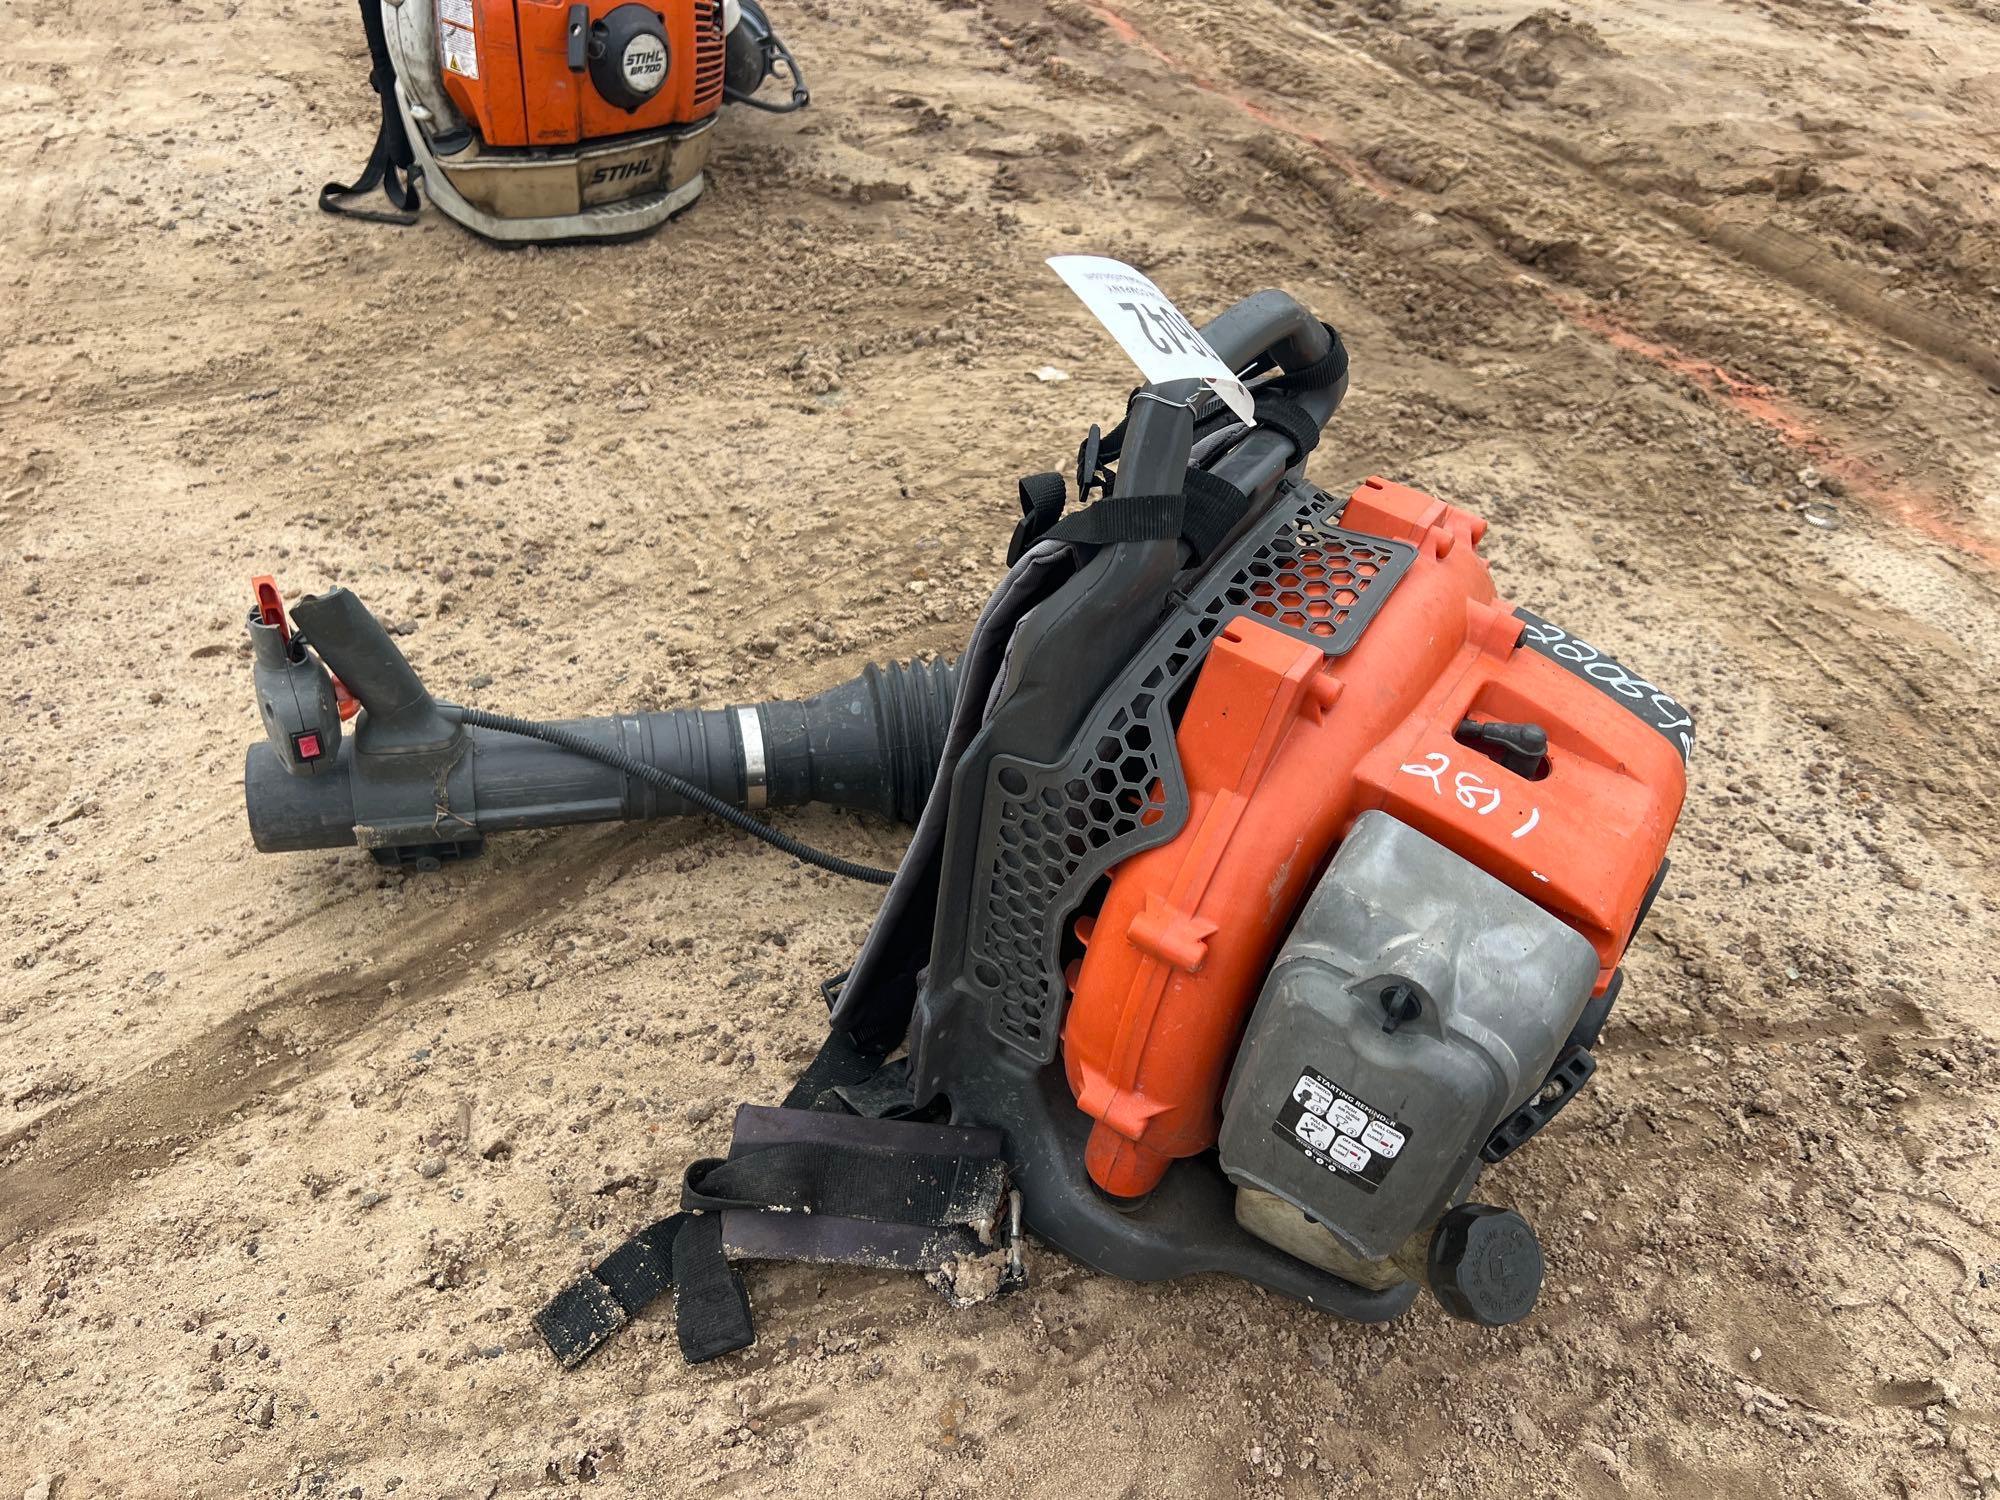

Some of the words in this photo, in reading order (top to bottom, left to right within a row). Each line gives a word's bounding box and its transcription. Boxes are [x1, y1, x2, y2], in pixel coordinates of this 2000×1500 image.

[625, 51, 663, 66] STIHL
[630, 67, 643, 76] BR
[644, 63, 662, 75] 700
[591, 159, 652, 184] STIHL
[1315, 1074, 1354, 1102] STARTING
